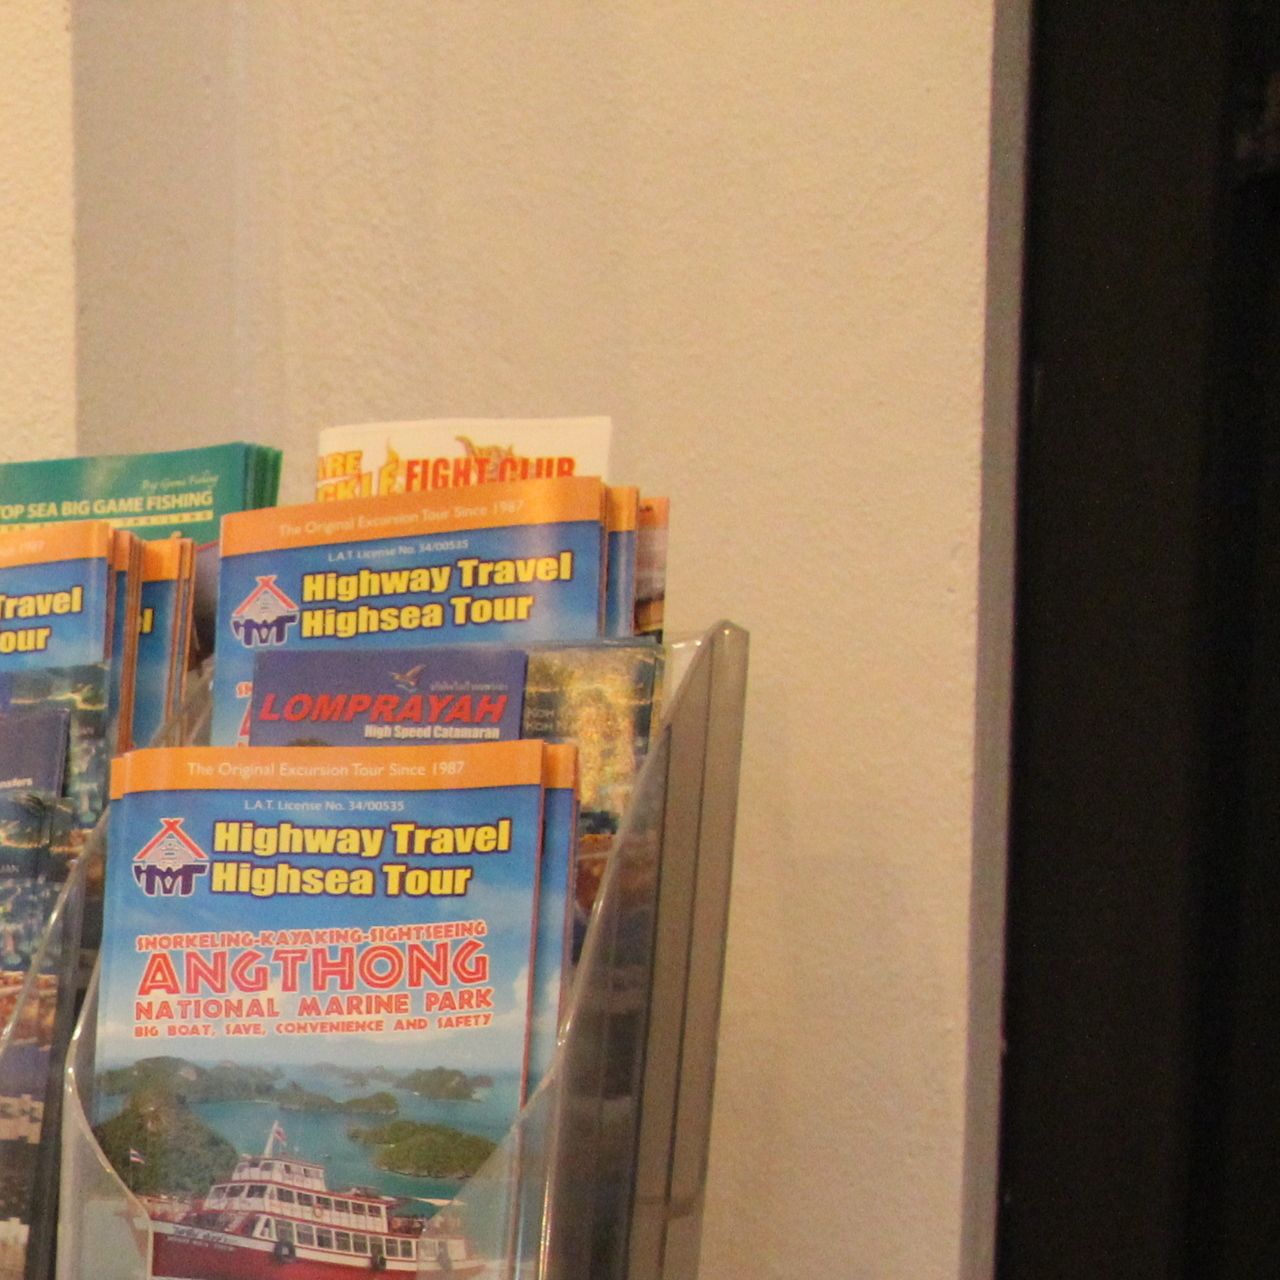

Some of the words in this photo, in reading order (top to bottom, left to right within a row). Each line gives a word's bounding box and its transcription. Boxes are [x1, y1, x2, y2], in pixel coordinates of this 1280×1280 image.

[405, 457, 488, 492] FIGHT
[27, 502, 58, 518] SEA
[62, 500, 90, 516] BIG
[93, 497, 144, 514] GAME
[147, 490, 213, 510] FISHING
[302, 565, 451, 602] Highway
[457, 552, 572, 588] Travel
[300, 604, 444, 638] Highsea
[449, 594, 533, 625] Tour
[258, 692, 509, 724] LOMPRAYAH
[188, 761, 213, 776] The
[219, 762, 275, 779] Original
[280, 762, 348, 776] Excursion
[353, 763, 384, 776] Tour
[389, 761, 426, 776] Since
[432, 760, 466, 775] 1987
[213, 821, 385, 857] Highway
[391, 819, 511, 854] Travel
[211, 862, 375, 896] Highsea
[382, 863, 473, 895] Tour
[136, 919, 487, 952] SNORKELING-KAYAKING-SIGHTSEEING
[136, 939, 489, 997] ANGTHONG
[135, 998, 280, 1021] NATIONAL
[298, 994, 410, 1017] MARINE
[425, 988, 494, 1013] PARK
